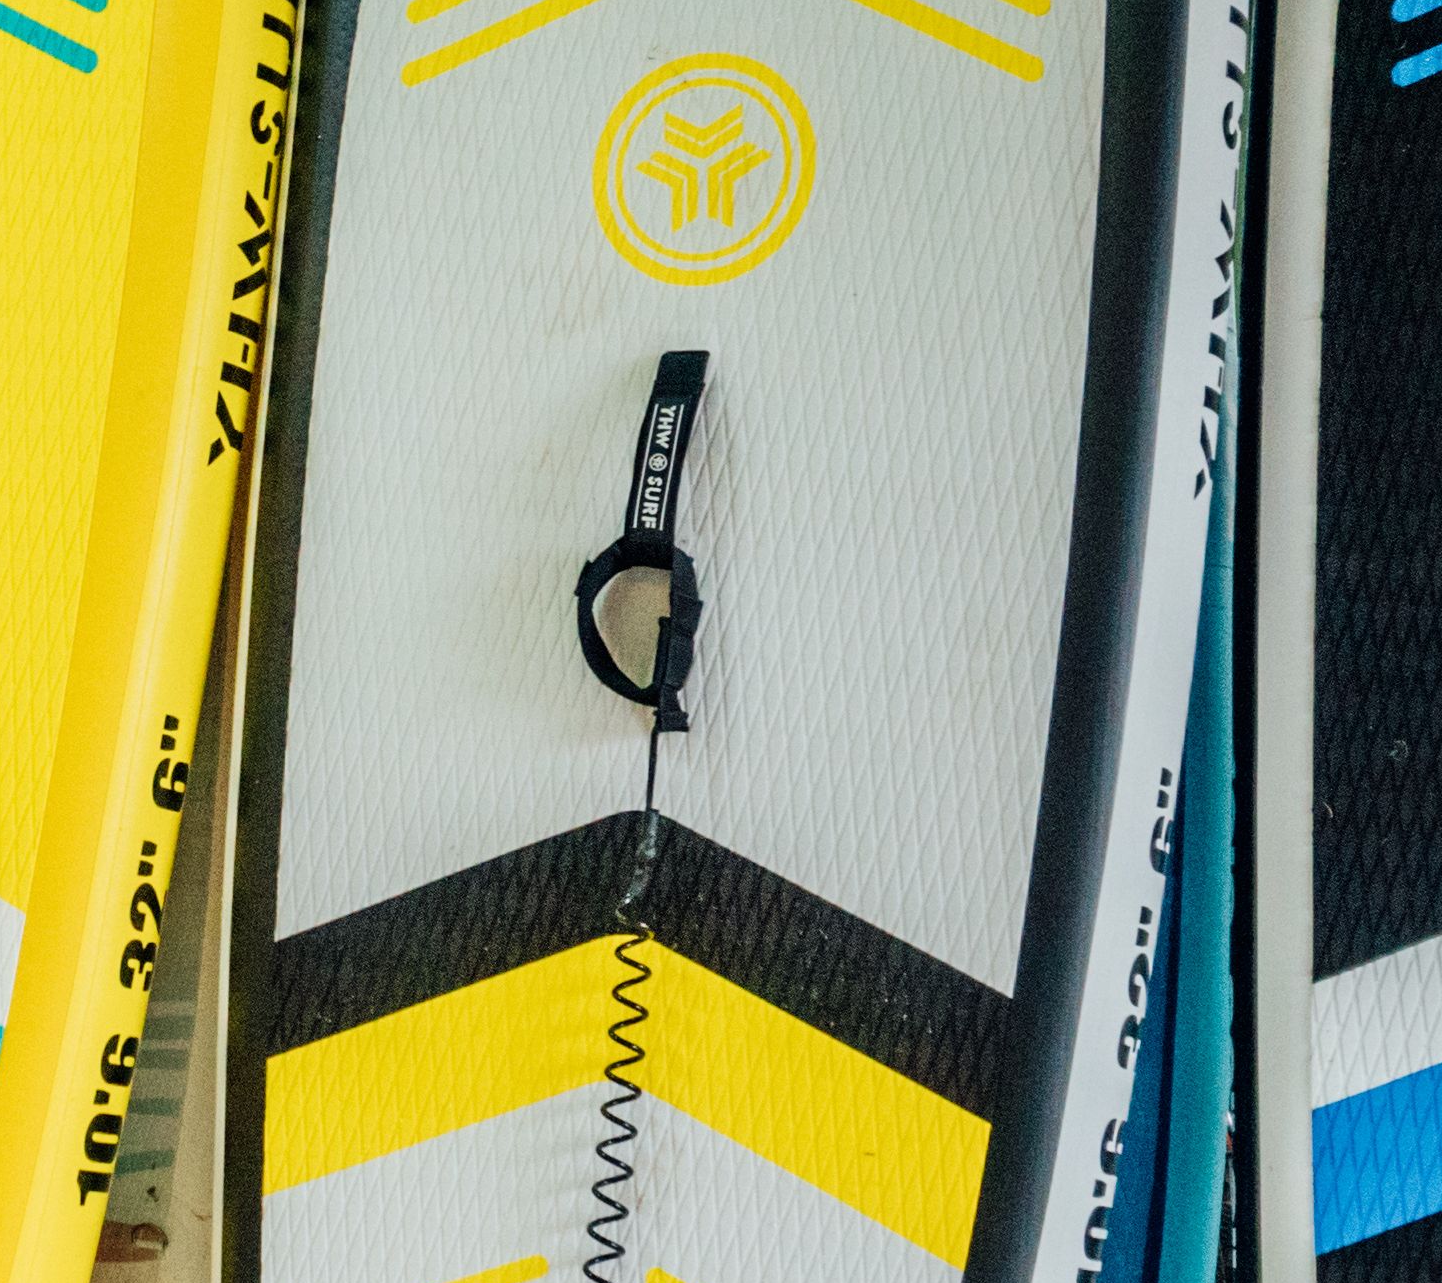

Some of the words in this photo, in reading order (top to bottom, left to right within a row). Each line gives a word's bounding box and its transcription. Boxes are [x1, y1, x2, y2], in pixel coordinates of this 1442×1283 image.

[655, 404, 677, 450] YHW
[640, 475, 663, 530] SURF
[77, 1034, 139, 1206] 10'6
[120, 840, 170, 991] 32"
[152, 714, 190, 813] 6"
